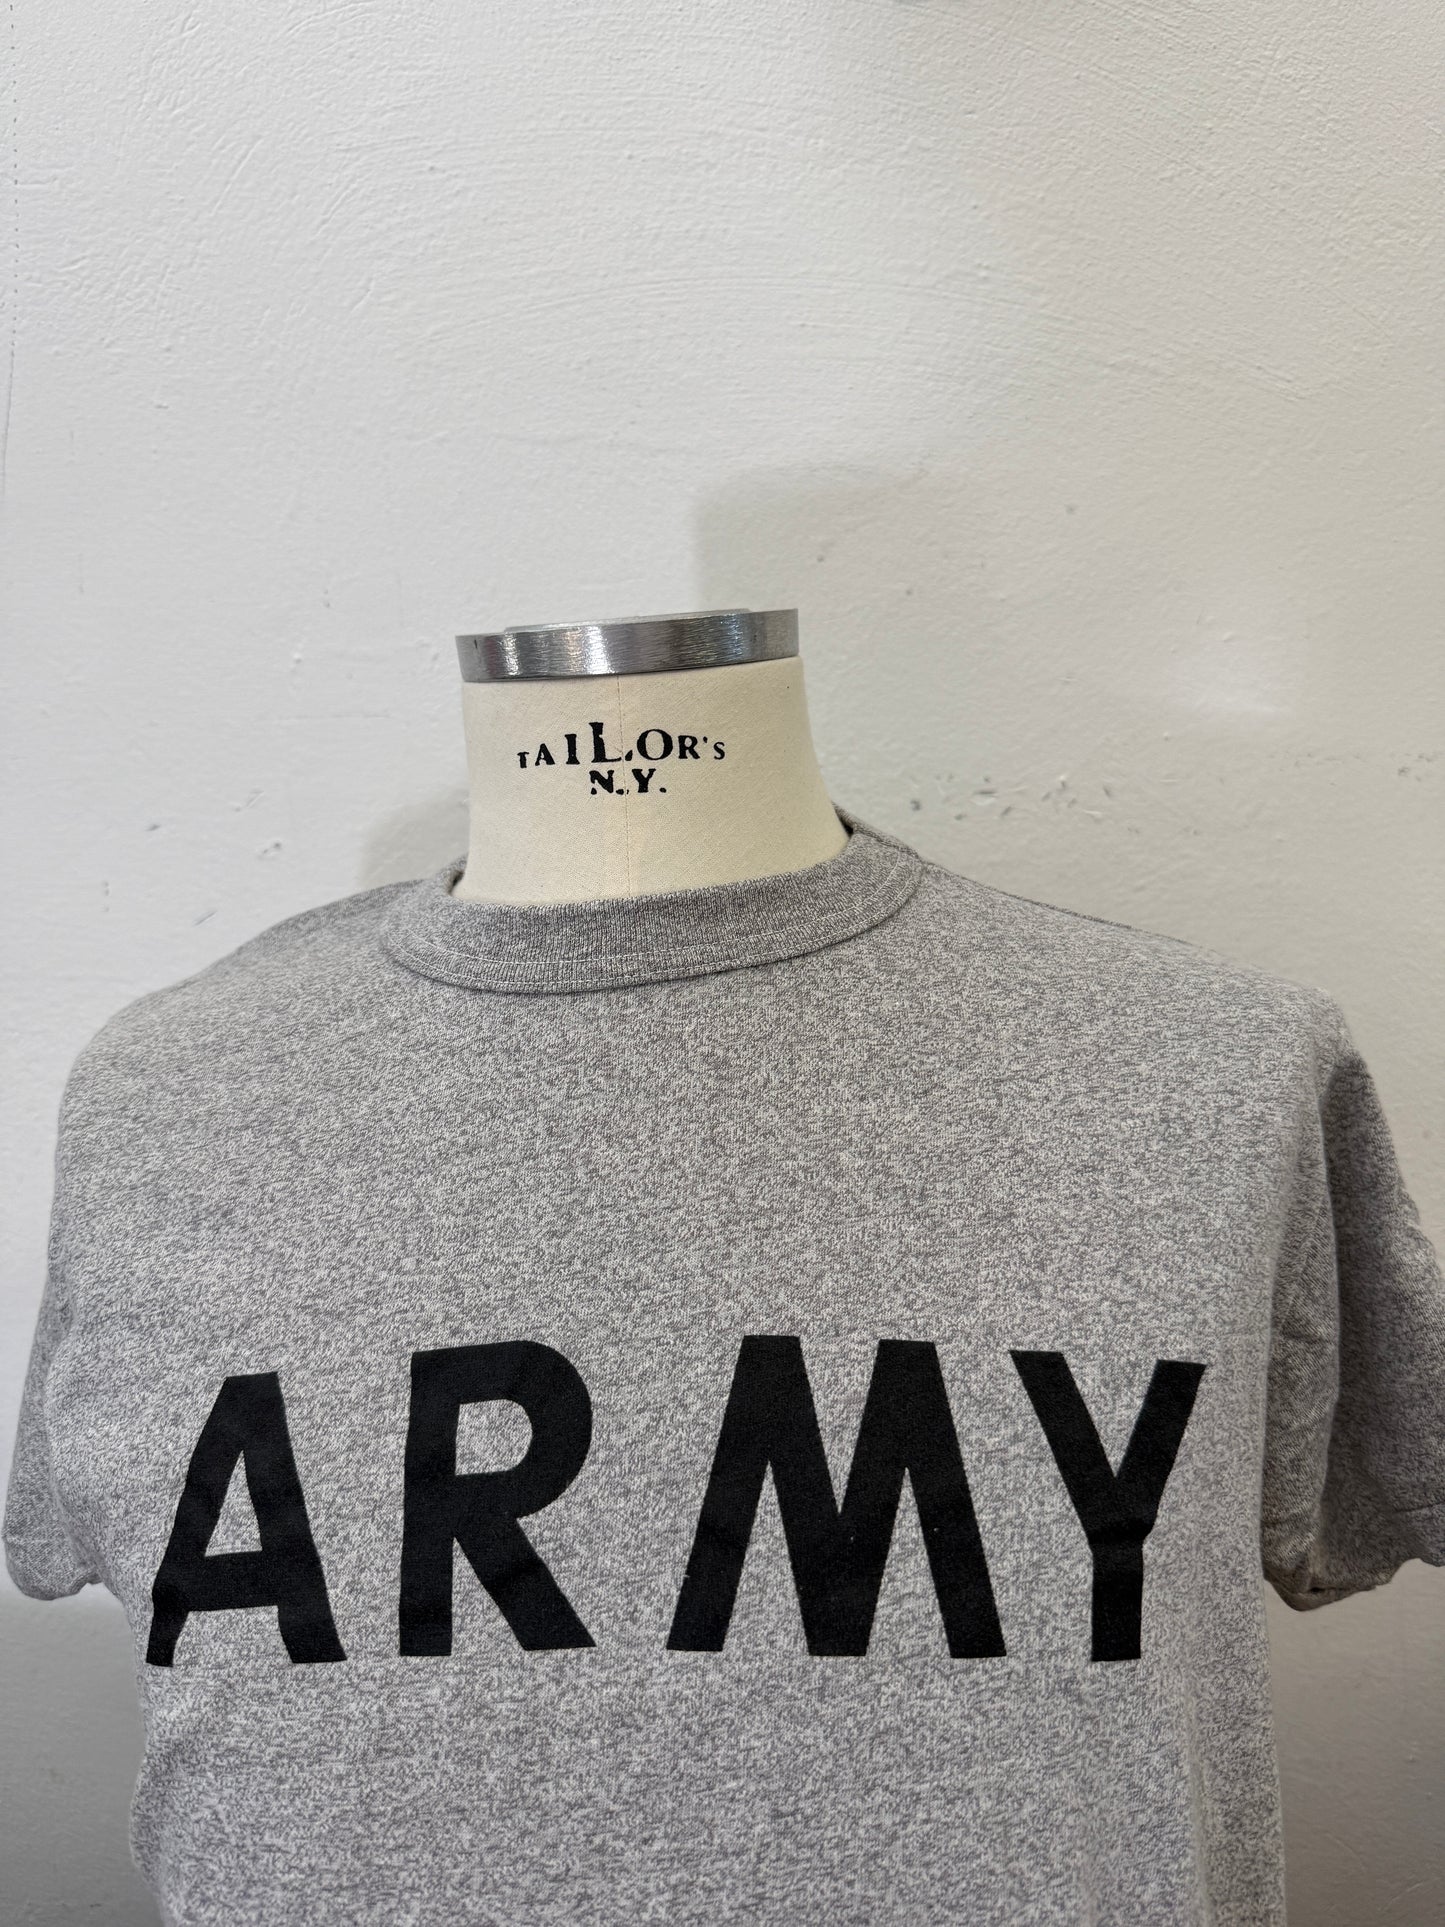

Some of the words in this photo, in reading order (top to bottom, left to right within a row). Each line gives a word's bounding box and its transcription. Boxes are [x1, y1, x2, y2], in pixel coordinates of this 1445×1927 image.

[516, 721, 727, 769] TAILOR'S
[588, 768, 668, 796] N.Y.
[145, 1334, 1207, 1668] ARMY
